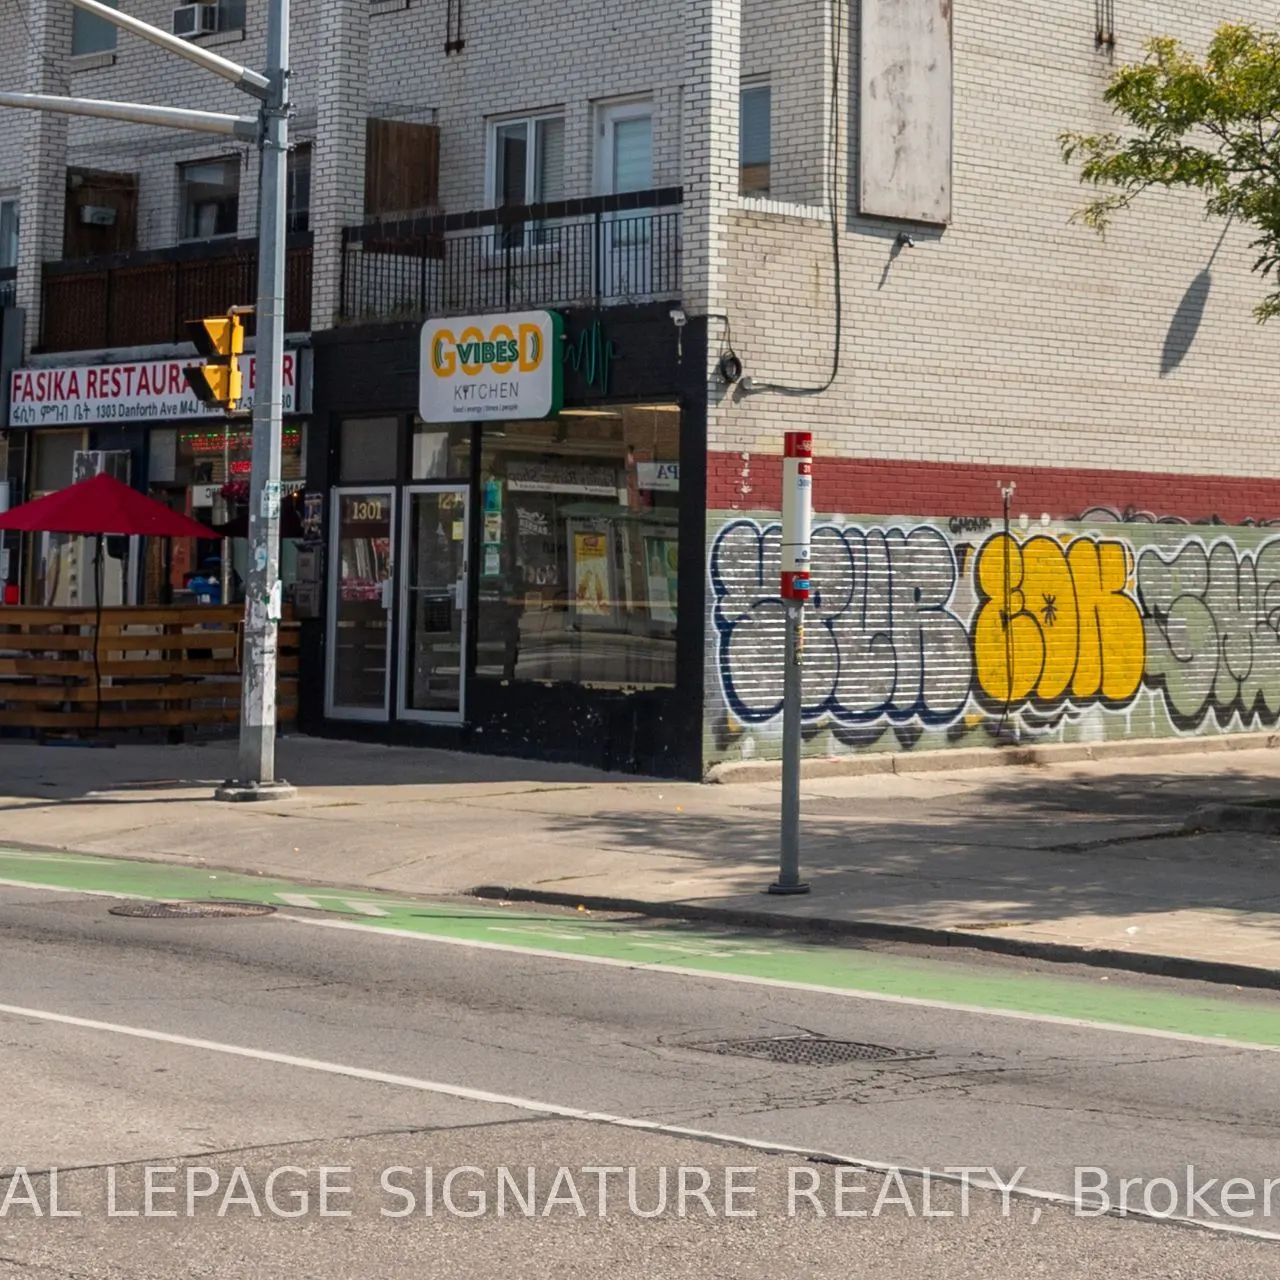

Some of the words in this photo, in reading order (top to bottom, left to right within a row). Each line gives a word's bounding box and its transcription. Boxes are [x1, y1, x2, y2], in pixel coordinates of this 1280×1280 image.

[431, 323, 543, 378] GOOD
[456, 339, 520, 364] VIBES
[12, 370, 80, 402] FASIKA
[86, 360, 205, 399] RESTAUR
[454, 382, 519, 400] KITCHEN
[96, 404, 116, 418] 1303
[118, 401, 157, 417] Danforth
[160, 401, 177, 415] Ave
[352, 501, 382, 520] 1301
